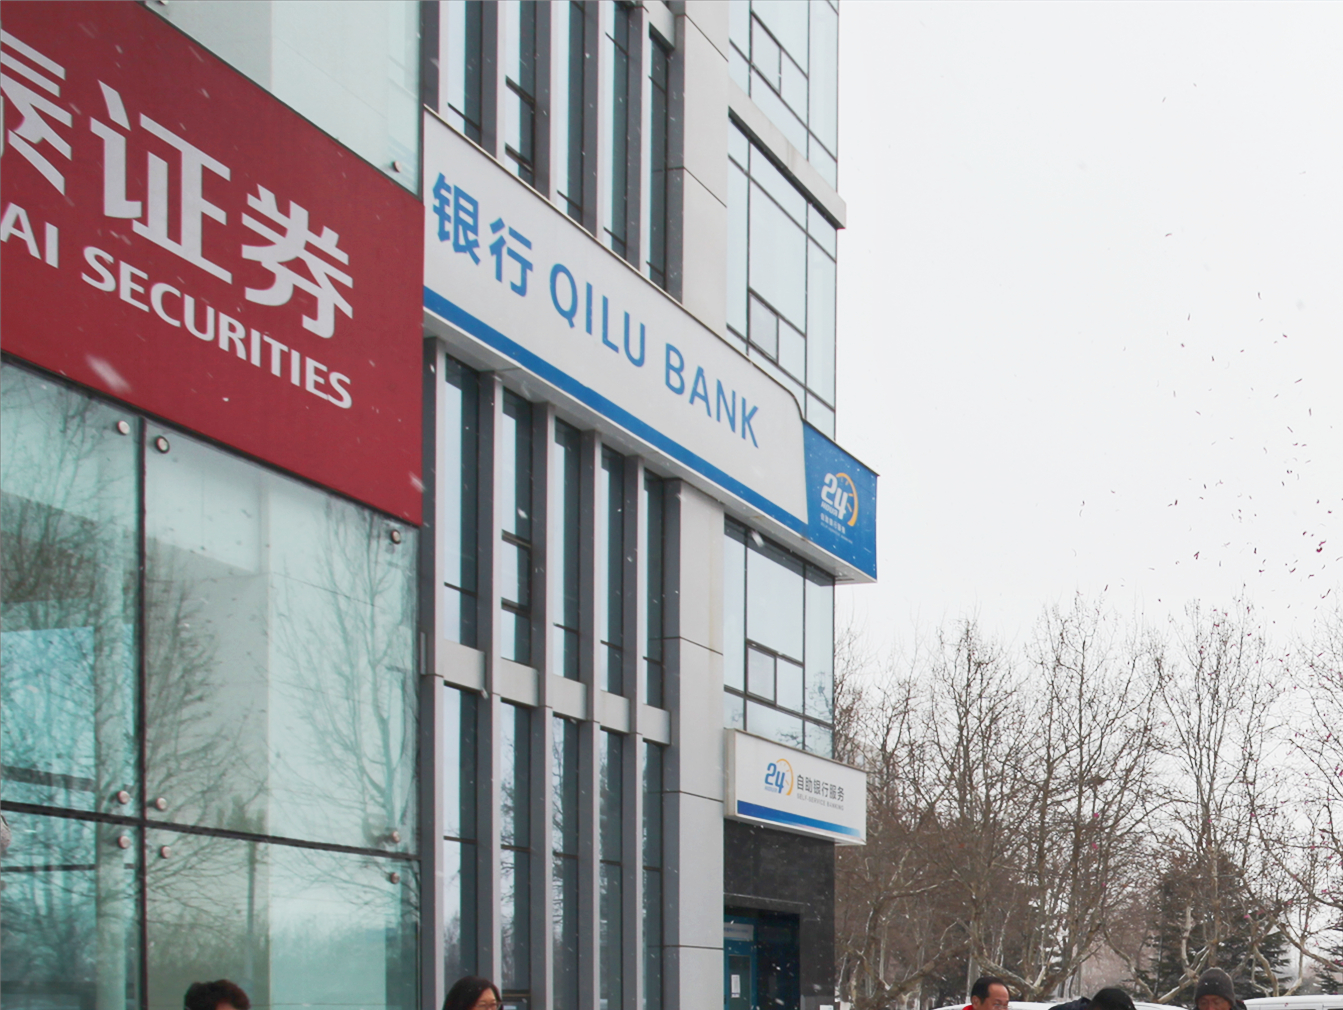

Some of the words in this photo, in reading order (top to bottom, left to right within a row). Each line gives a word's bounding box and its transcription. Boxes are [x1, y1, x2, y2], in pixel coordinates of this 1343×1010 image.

[432, 172, 534, 297] 银行
[81, 246, 352, 409] SECURITIES
[549, 263, 645, 367] QILU
[665, 343, 759, 449] BANK
[821, 473, 848, 520] 24
[765, 763, 785, 793] 24
[797, 774, 845, 802] 自助银行服务
